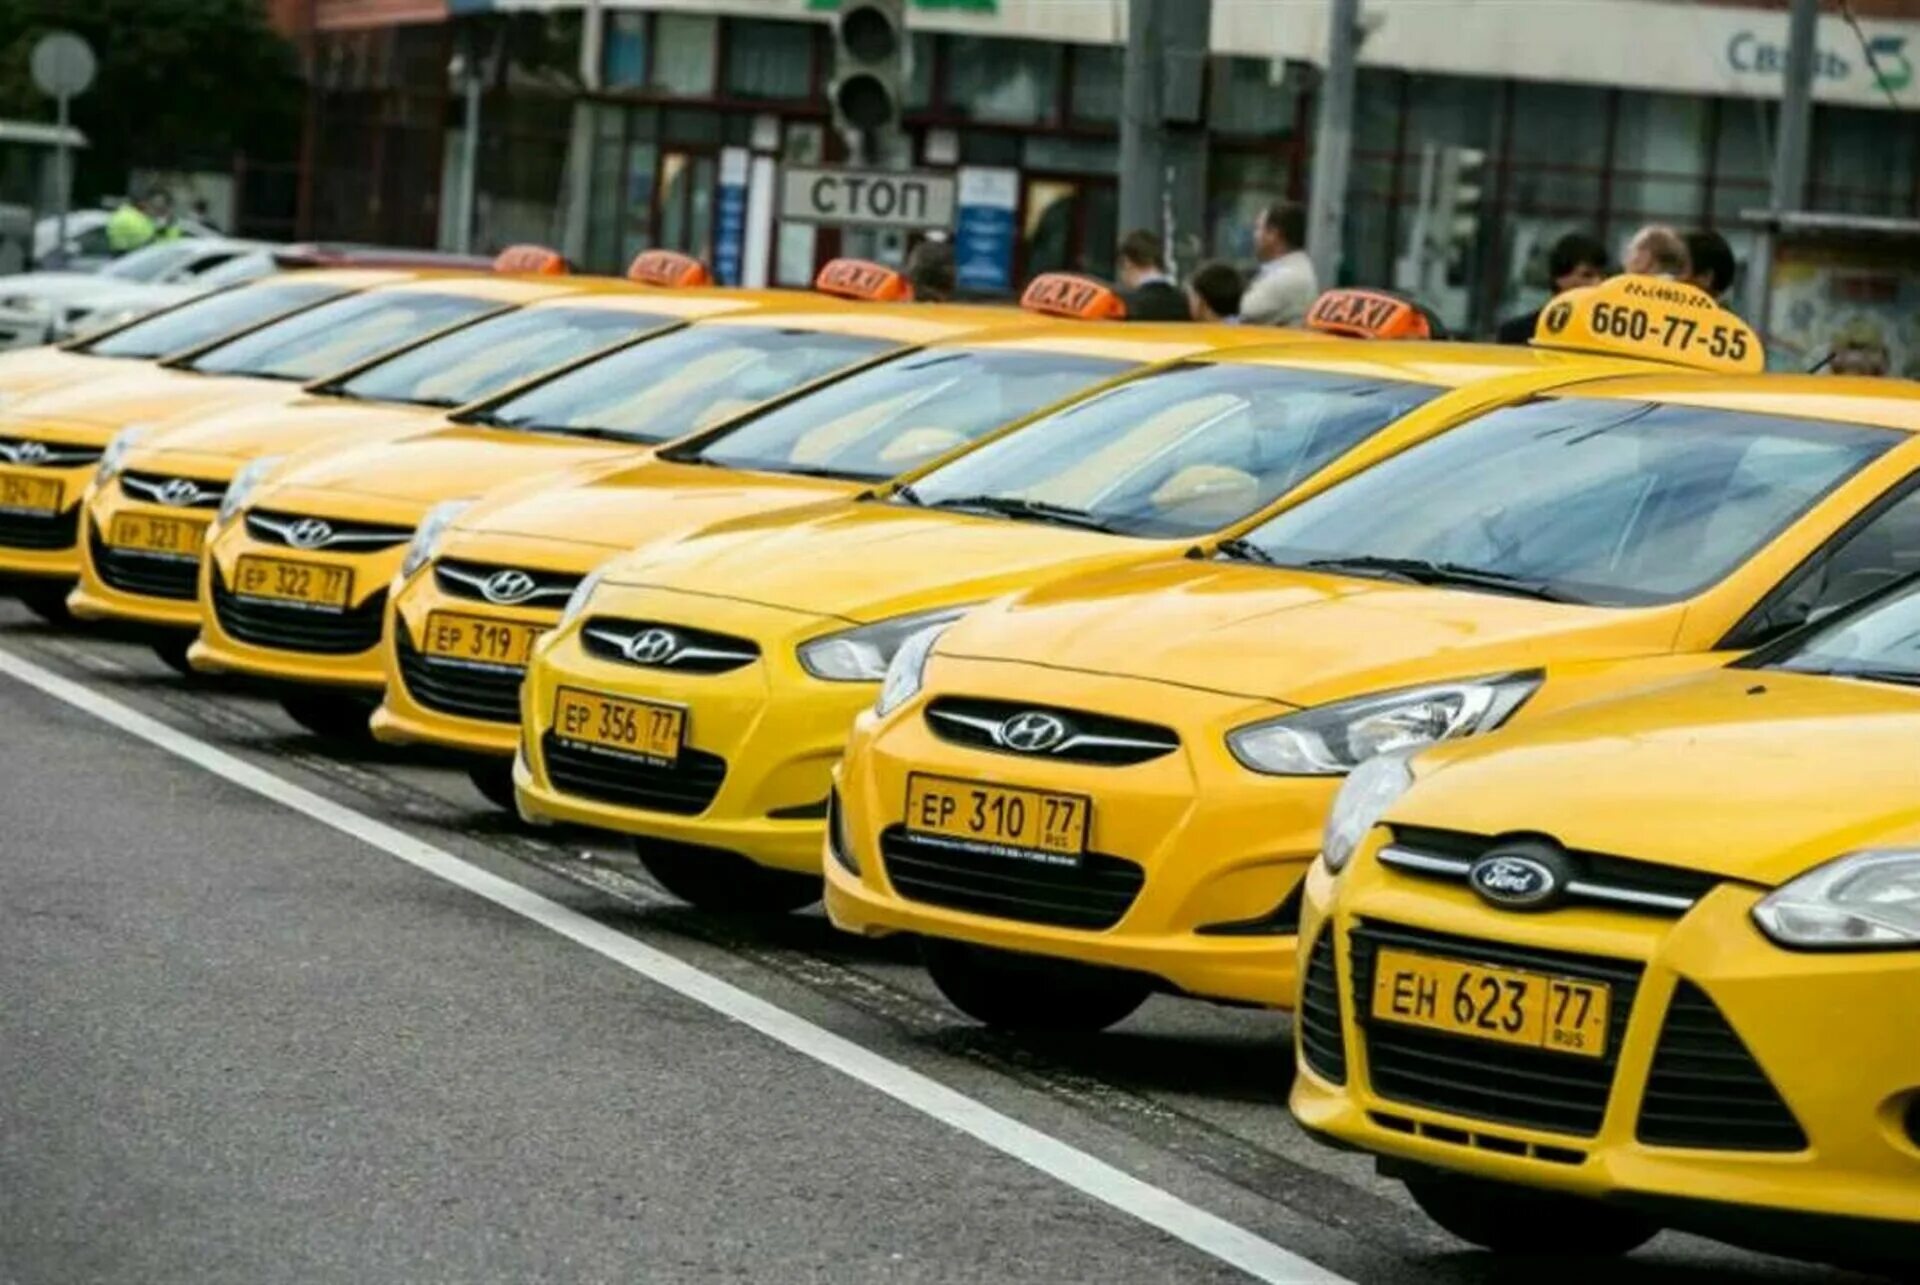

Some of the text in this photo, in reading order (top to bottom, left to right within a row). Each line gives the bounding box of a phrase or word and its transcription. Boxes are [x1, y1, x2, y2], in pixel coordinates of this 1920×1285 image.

[811, 176, 927, 219] СТОП
[1316, 296, 1398, 329] TAXI
[1592, 302, 1747, 361] 660-77-55
[274, 565, 310, 597] 322
[469, 623, 512, 657] 319
[564, 702, 674, 744] EP 356 77
[921, 790, 1076, 838] EP 310 77
[1483, 862, 1535, 892] Ford
[1391, 971, 1594, 1035] EH 623 77
